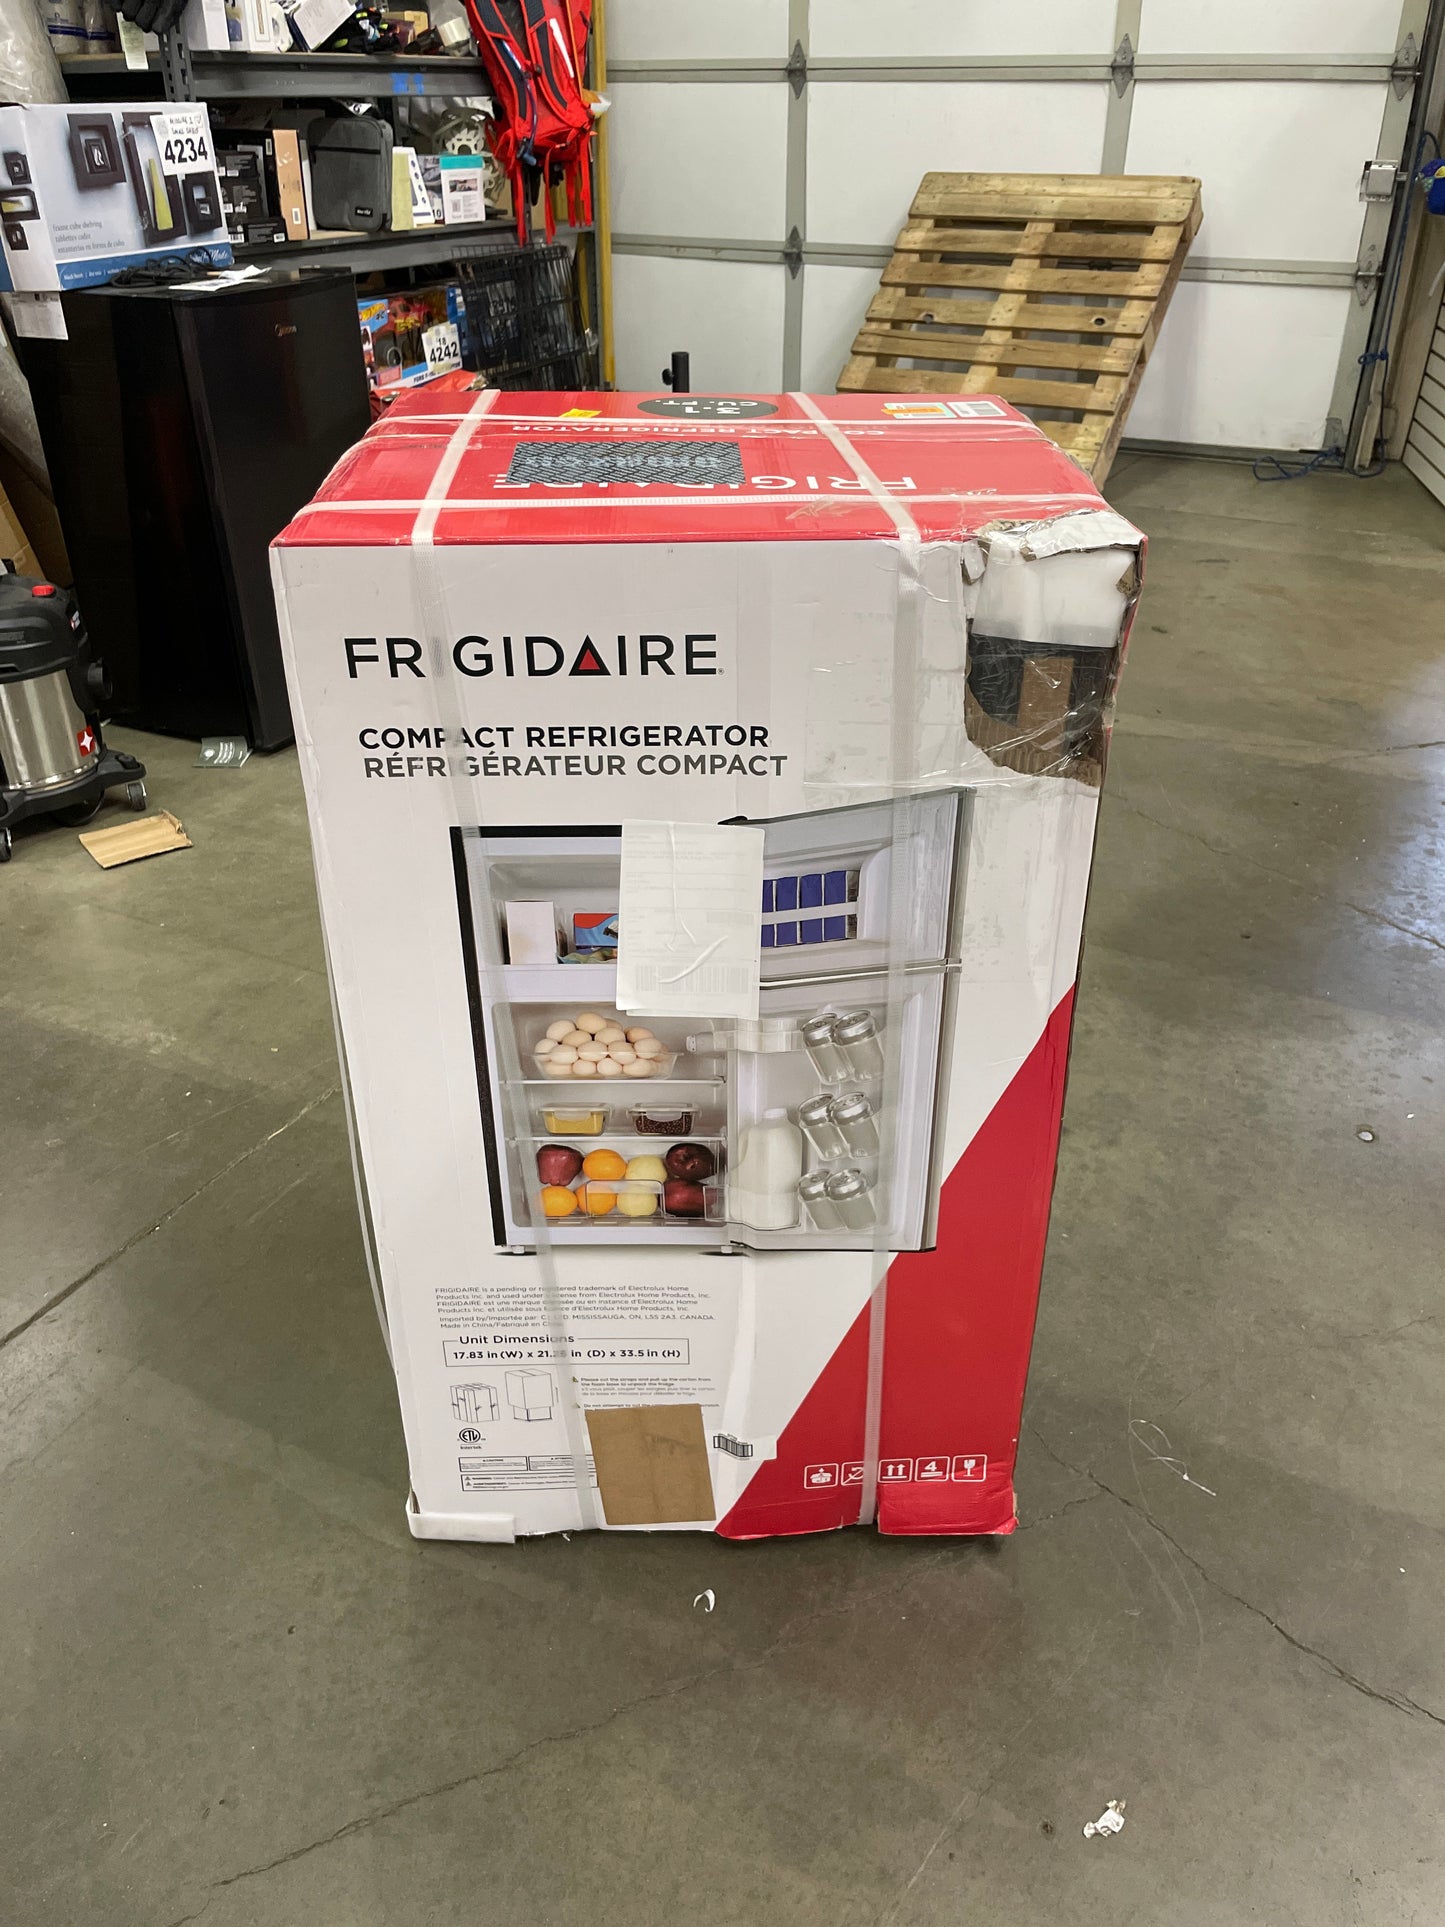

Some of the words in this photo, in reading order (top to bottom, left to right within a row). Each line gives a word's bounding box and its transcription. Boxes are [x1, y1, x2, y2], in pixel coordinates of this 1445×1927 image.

[164, 136, 208, 165] 4234
[429, 341, 459, 363] 4242
[685, 406, 741, 415] 3.1
[513, 425, 736, 433] REFRIGERATOR
[750, 428, 885, 437] COPACT
[525, 725, 769, 748] REFRIGERATOR
[363, 750, 627, 779] RÉFRGÉRATEUR
[636, 754, 788, 777] COMPACT
[496, 1285, 527, 1293] pending
[439, 1315, 475, 1323] Imported
[459, 1335, 489, 1346] Unit
[493, 1334, 575, 1345] Dimensions
[453, 1351, 484, 1360] 17.83
[487, 1349, 498, 1359] in
[500, 1350, 523, 1360] (W)
[571, 1349, 582, 1358] in
[587, 1349, 606, 1359] (D)
[619, 1348, 645, 1358] 33.5
[647, 1348, 658, 1357] in
[662, 1348, 681, 1358] (H)
